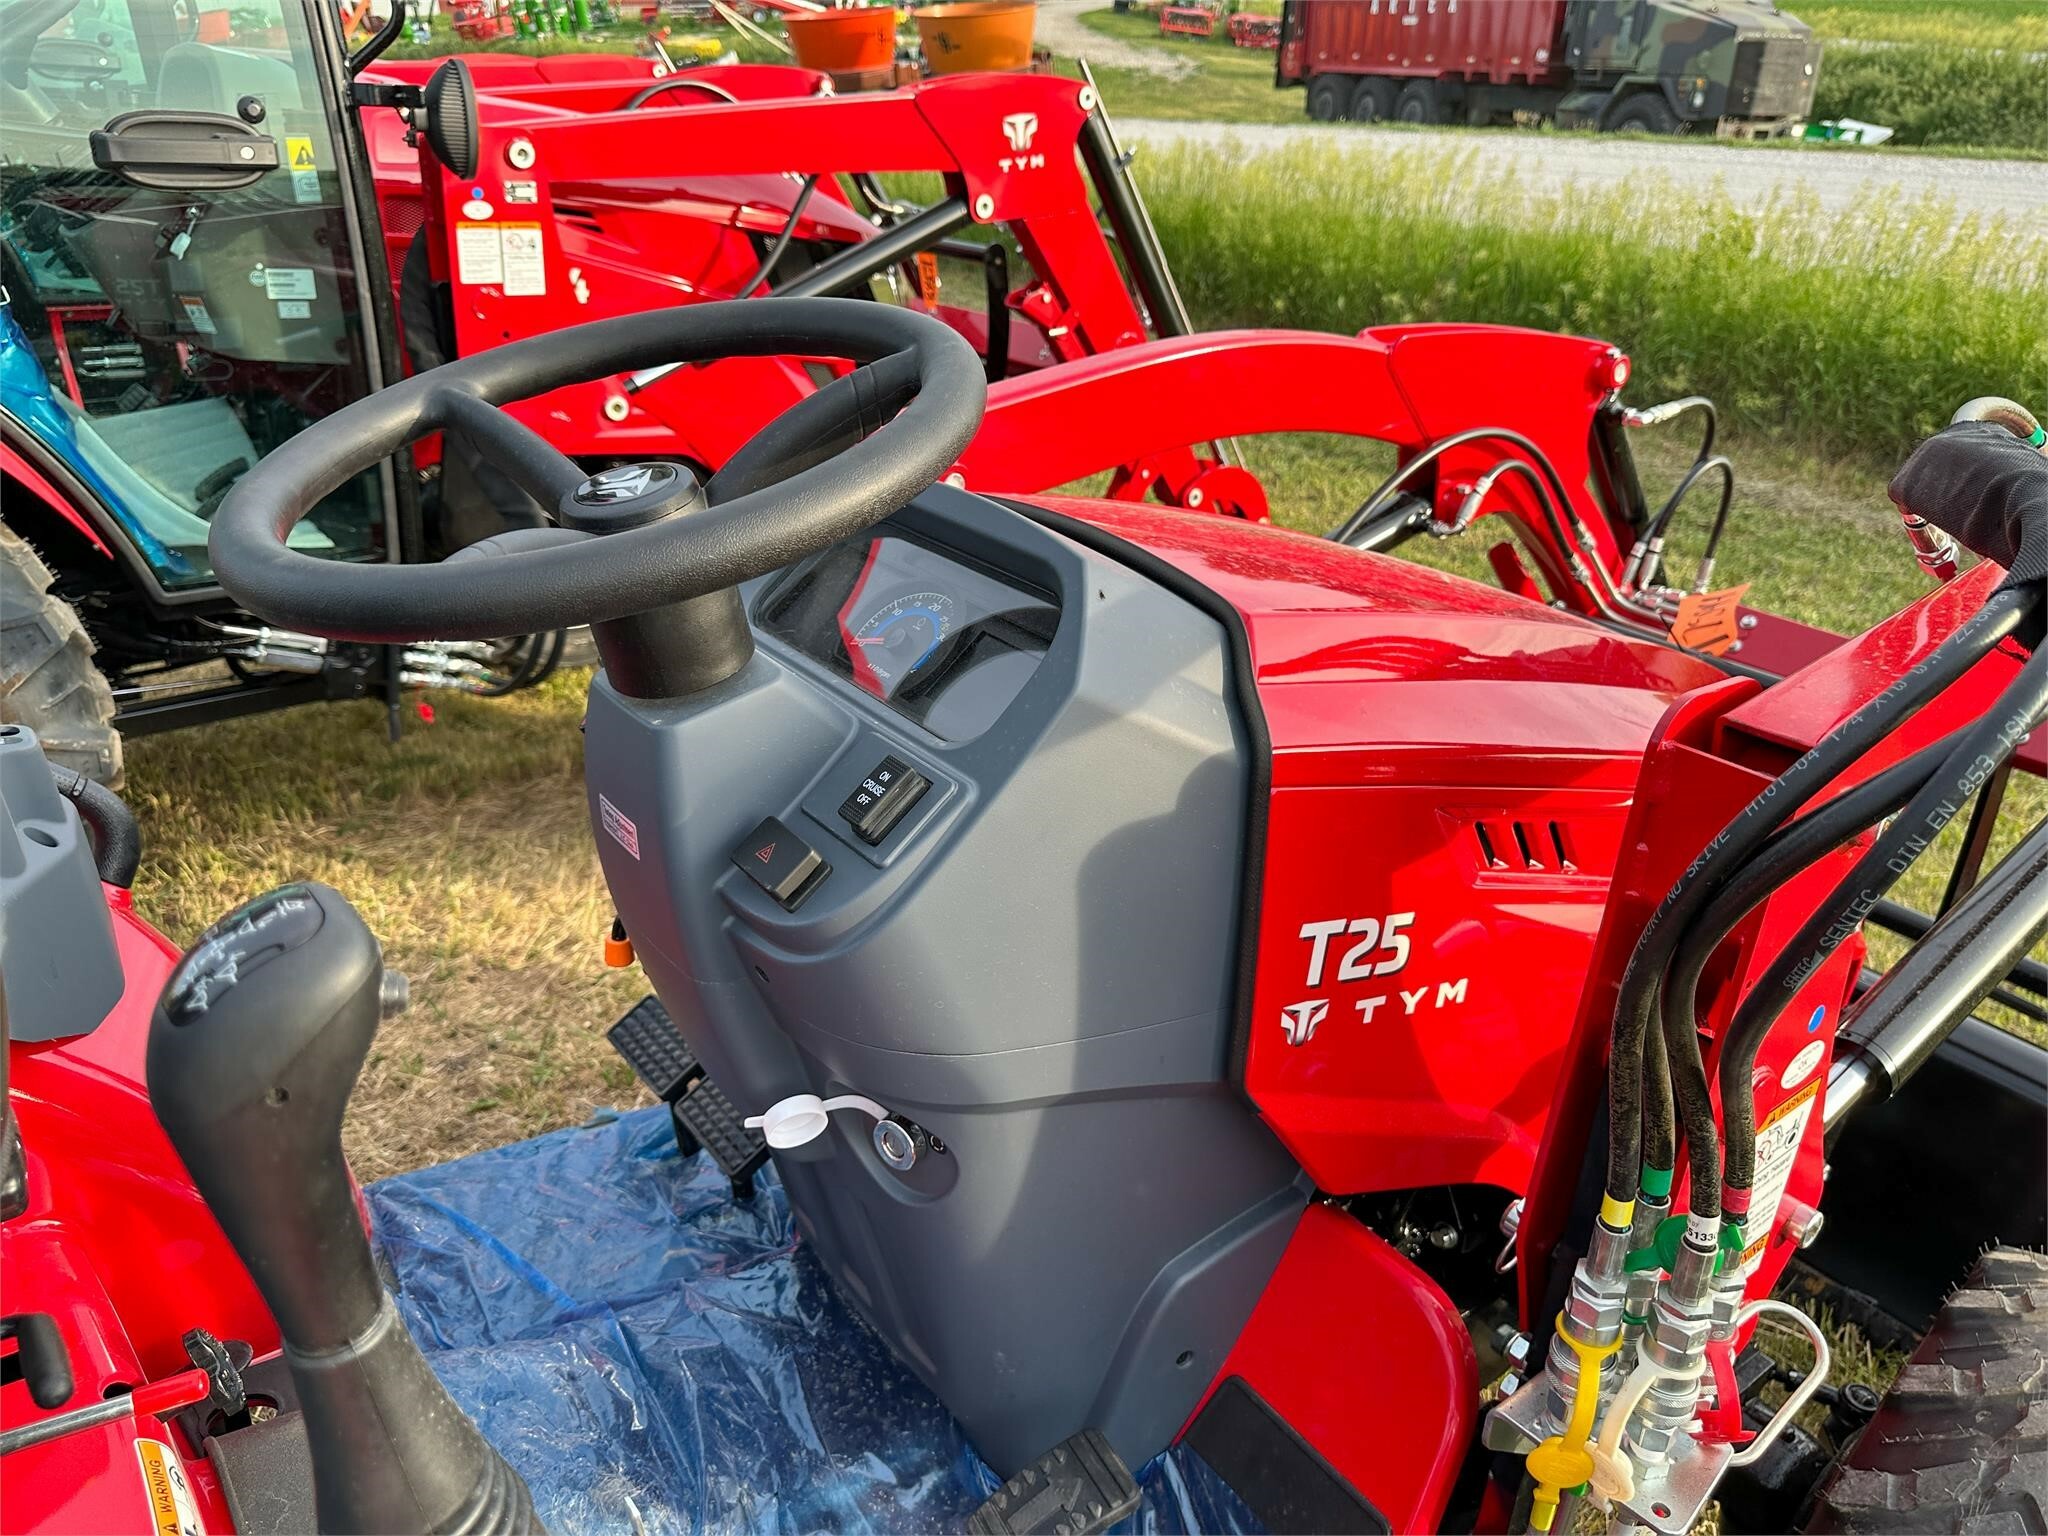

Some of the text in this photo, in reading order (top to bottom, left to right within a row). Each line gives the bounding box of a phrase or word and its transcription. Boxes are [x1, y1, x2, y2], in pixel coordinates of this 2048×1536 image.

[998, 153, 1045, 173] TYM
[892, 608, 904, 616] 10
[928, 603, 942, 612] 20
[880, 771, 892, 782] ON
[862, 778, 885, 797] CRUISE
[857, 793, 872, 805] OFF
[1686, 831, 1731, 878] SKIVE
[1819, 889, 1881, 949] SENTEC
[1887, 834, 1928, 873] DIN
[1925, 799, 1957, 830] EN
[1957, 754, 1995, 796] 853
[1299, 912, 1416, 987] T25
[1355, 978, 1469, 1024] TYM
[149, 1459, 172, 1512] WARNING
